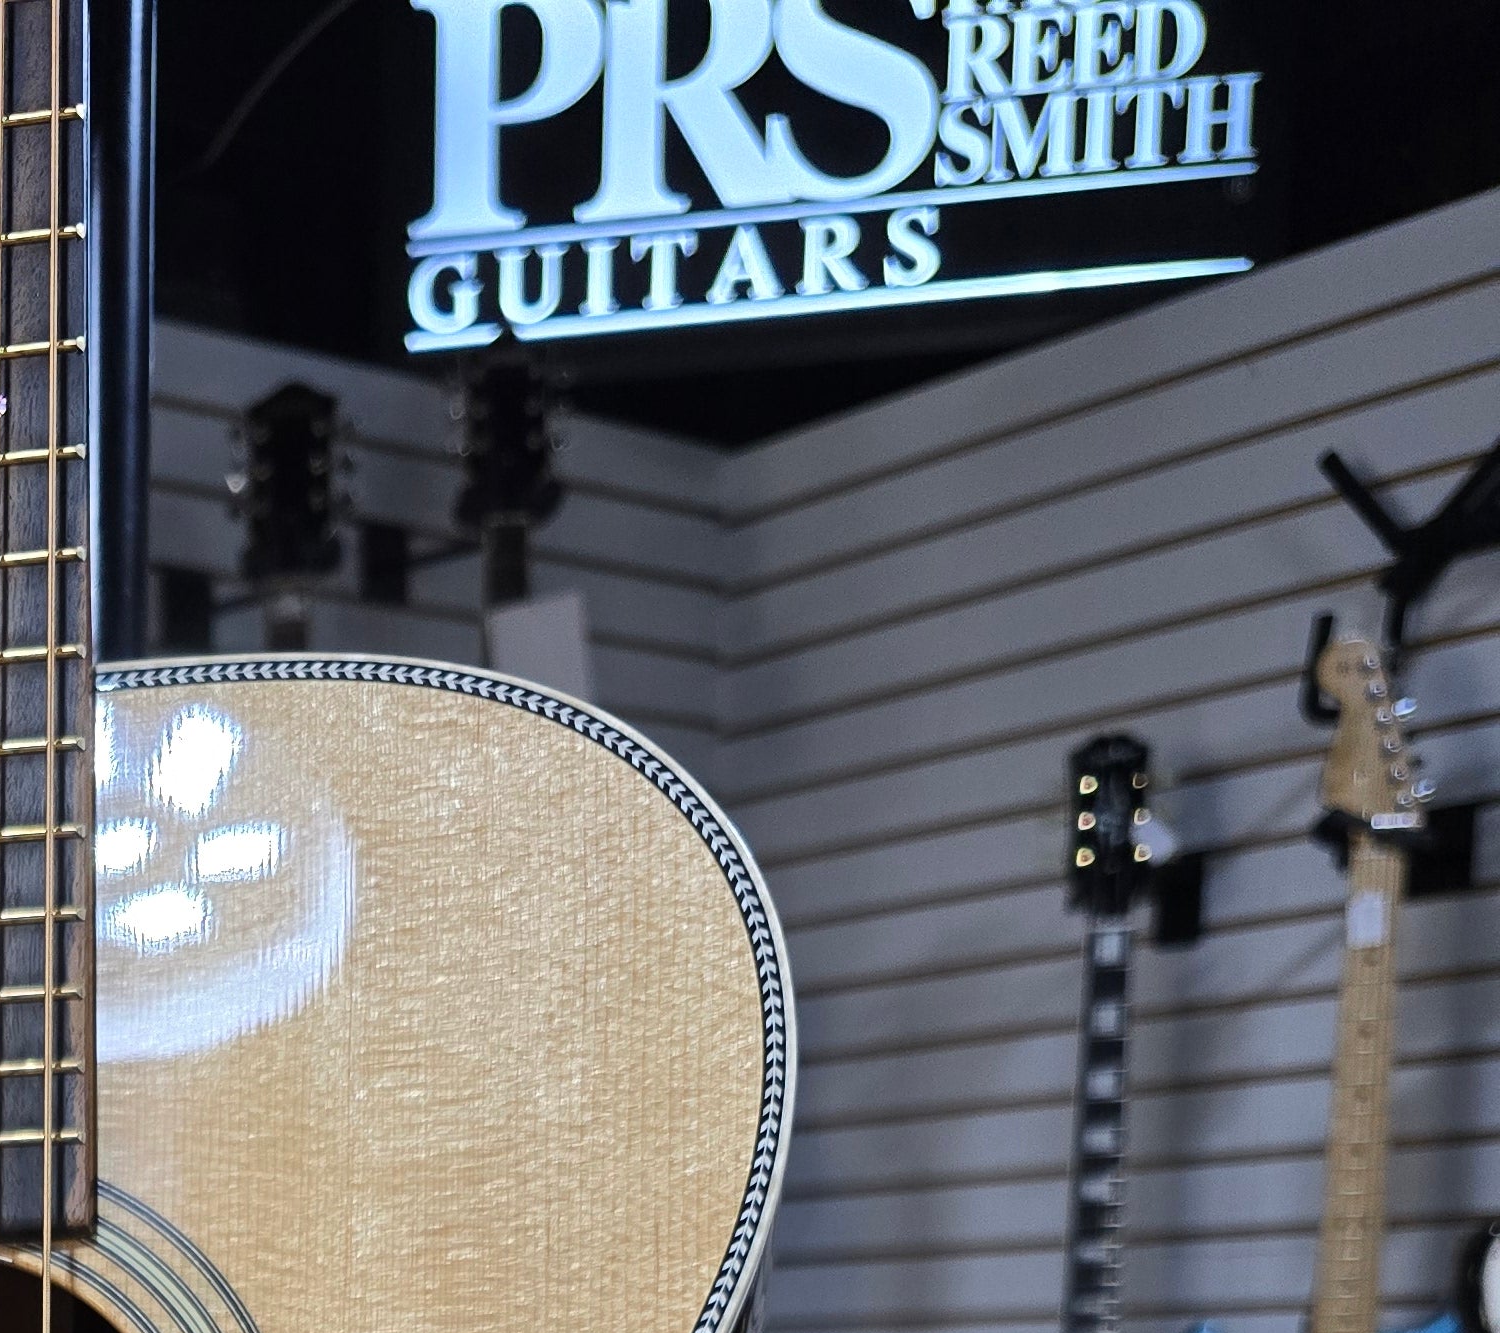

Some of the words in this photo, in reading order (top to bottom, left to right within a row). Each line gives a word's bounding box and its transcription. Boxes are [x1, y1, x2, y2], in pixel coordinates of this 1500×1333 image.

[941, 0, 1208, 104] REED
[406, 0, 939, 240] PRS
[933, 72, 1265, 188] SMITH
[407, 206, 942, 335] GUITARS
